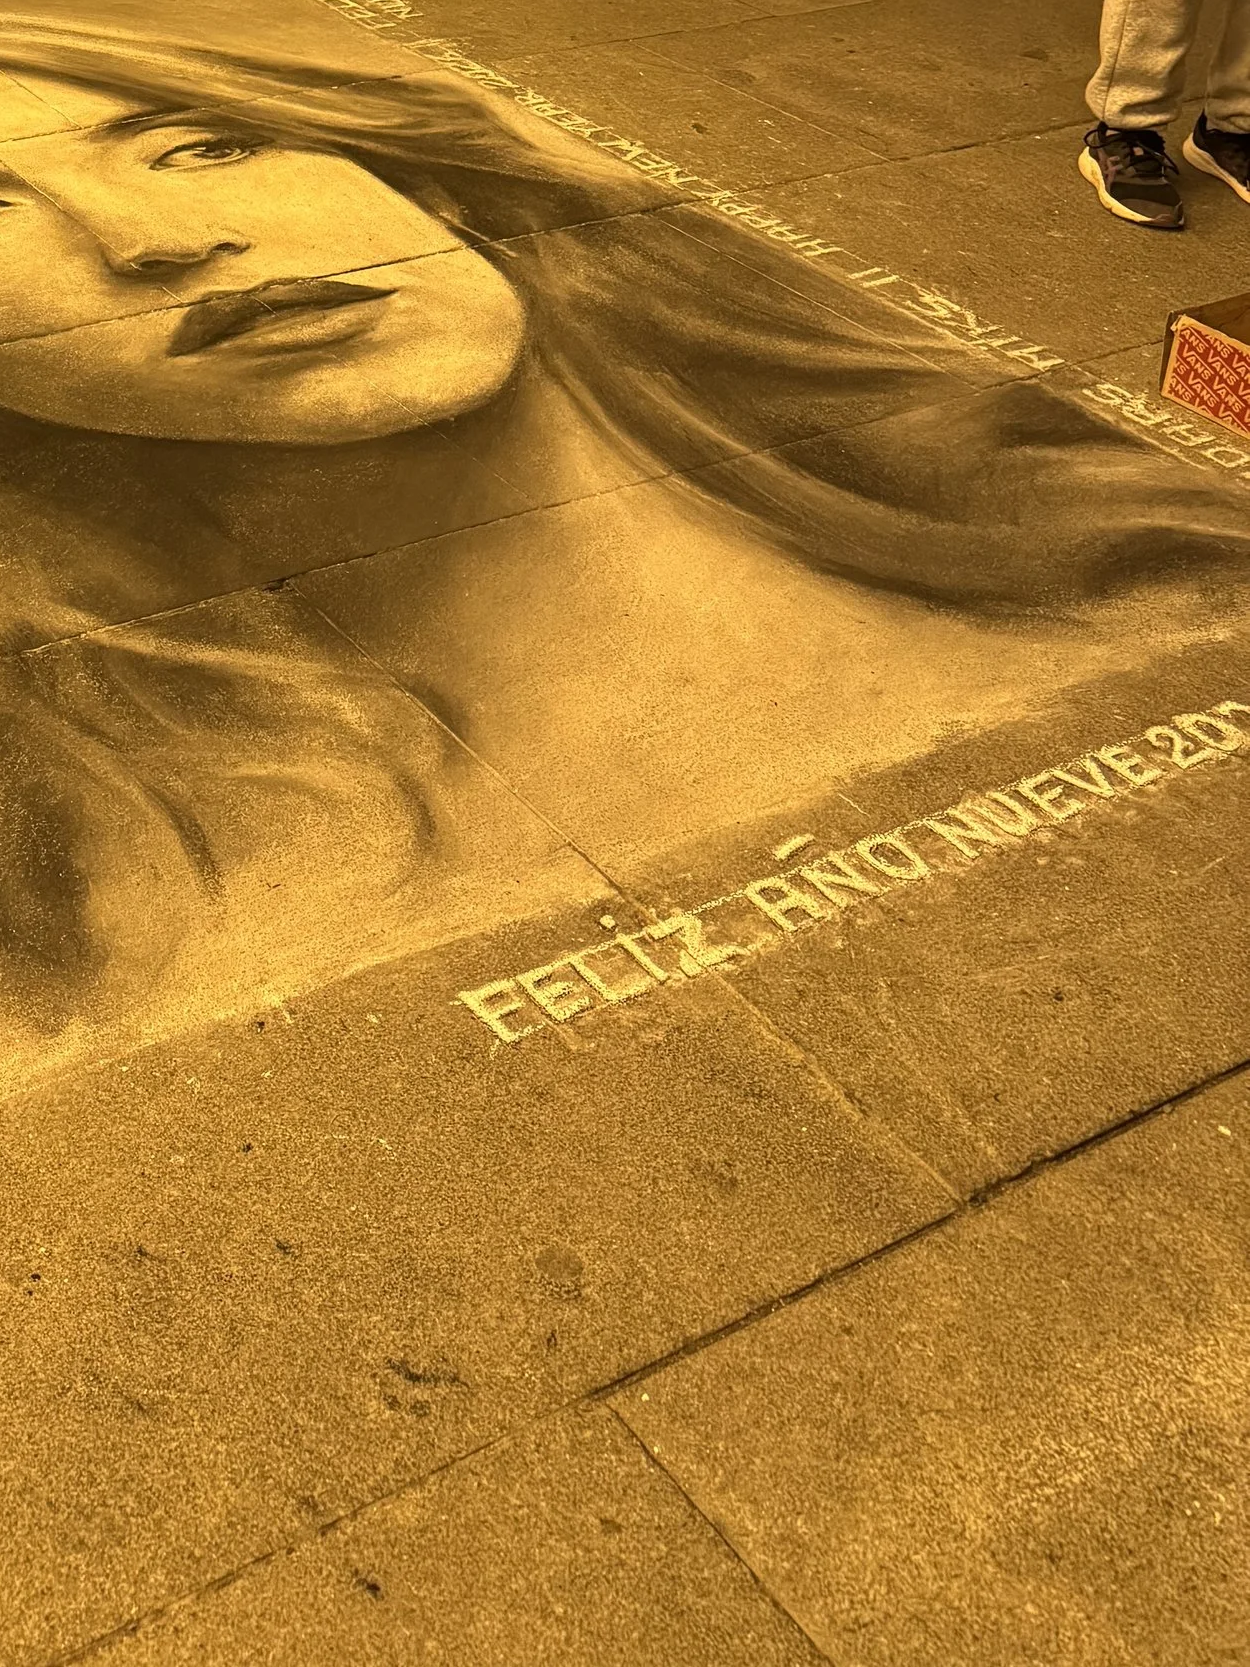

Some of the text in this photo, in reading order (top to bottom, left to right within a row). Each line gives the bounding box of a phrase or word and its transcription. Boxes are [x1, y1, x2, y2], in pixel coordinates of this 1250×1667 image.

[514, 88, 613, 138] YEAR
[598, 138, 701, 189] NEW
[691, 190, 844, 257] HAPPY
[1183, 343, 1215, 380] VANS
[1213, 376, 1246, 413] VANS
[1188, 371, 1220, 408] VANS
[1207, 349, 1240, 386] VANS
[745, 833, 931, 933] AÑO
[923, 744, 1164, 859] NUEVE
